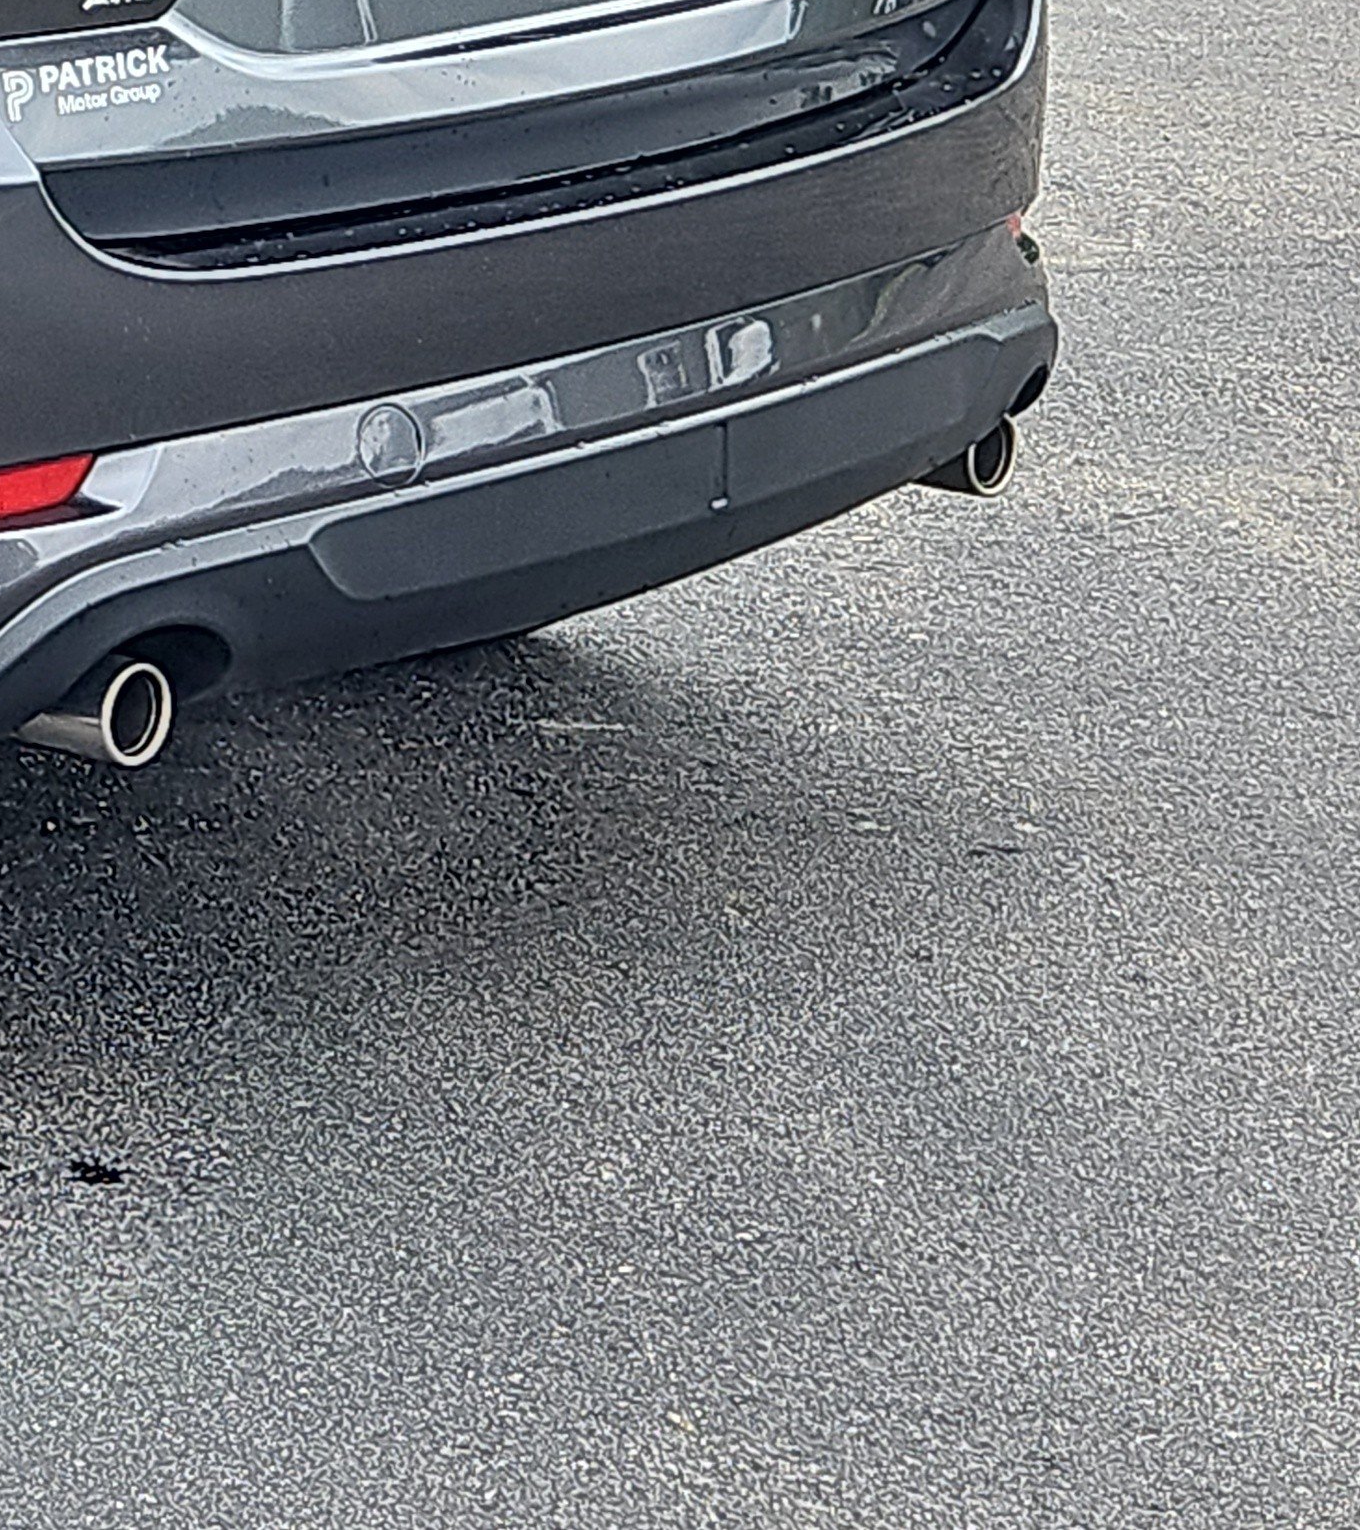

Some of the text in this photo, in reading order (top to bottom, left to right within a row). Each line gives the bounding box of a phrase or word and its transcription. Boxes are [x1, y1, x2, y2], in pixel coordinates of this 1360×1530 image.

[39, 45, 171, 93] PATRICK
[57, 82, 162, 116] Motor Group
